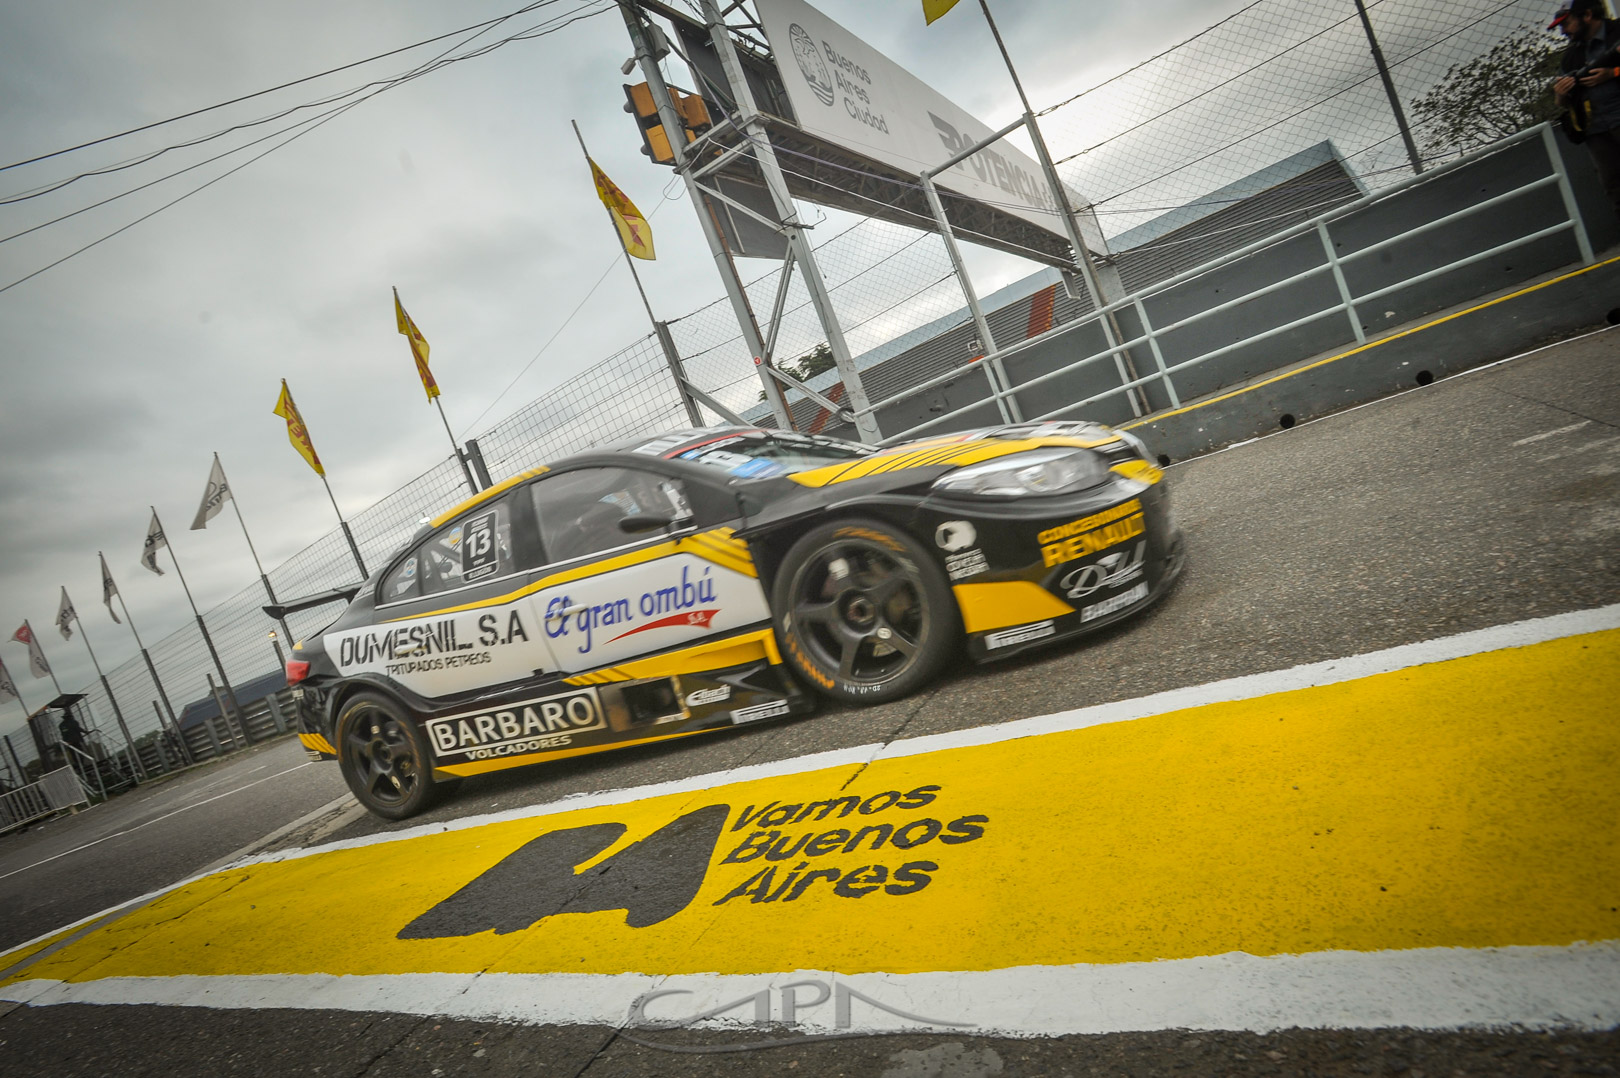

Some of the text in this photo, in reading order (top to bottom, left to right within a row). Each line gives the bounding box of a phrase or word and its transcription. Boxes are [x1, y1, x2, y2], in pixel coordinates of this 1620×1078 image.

[822, 40, 871, 85] Buenos
[834, 69, 870, 105] Aires
[844, 97, 889, 135] Ciudad
[466, 528, 491, 558] 13
[577, 598, 633, 654] gran
[640, 565, 718, 617] ombú
[340, 618, 474, 668] DUMESNIL
[433, 696, 596, 751] BARBARO
[465, 735, 573, 761] VOLCADORES
[730, 785, 942, 832] Vamos
[719, 815, 989, 865] Buenos
[712, 860, 939, 906] Aires
